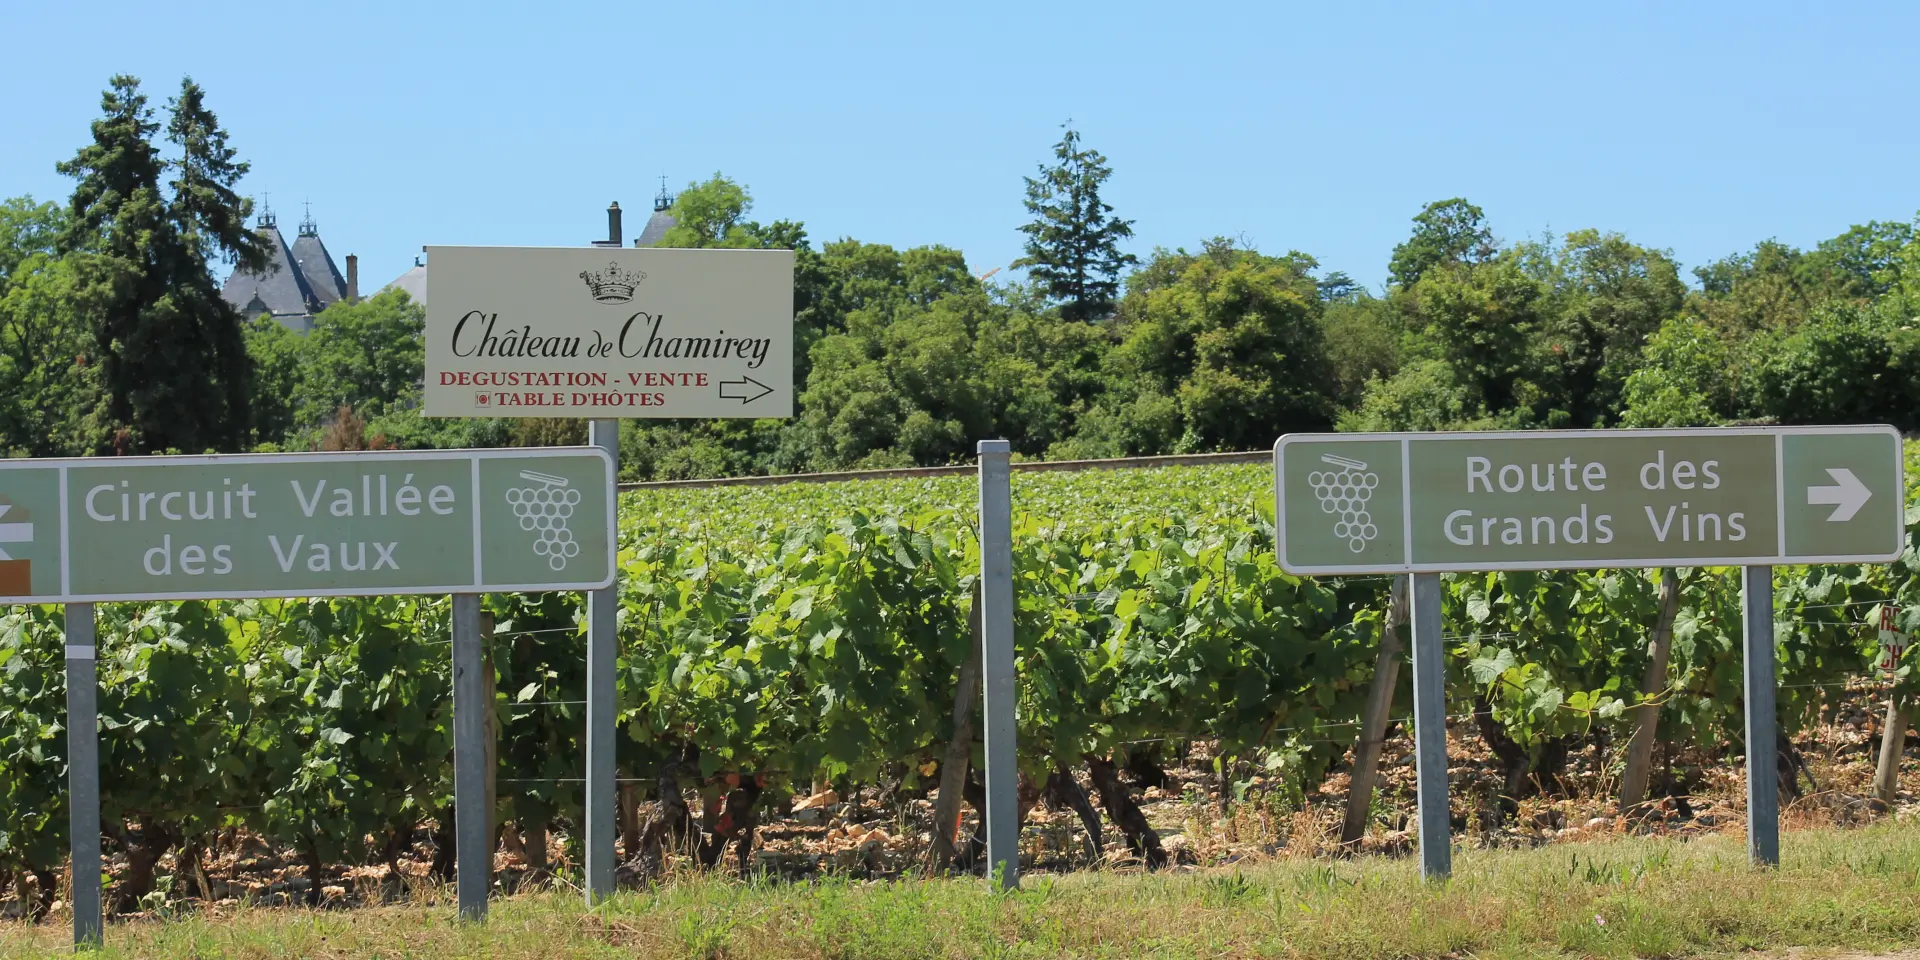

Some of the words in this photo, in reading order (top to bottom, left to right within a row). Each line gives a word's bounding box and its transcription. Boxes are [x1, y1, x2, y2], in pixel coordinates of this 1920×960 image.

[451, 310, 580, 358] Château
[587, 329, 613, 358] de
[618, 311, 771, 369] Chamirey
[439, 371, 607, 387] DEGUSTATION
[629, 371, 709, 387] VENTE
[494, 391, 566, 407] TABLE
[571, 389, 665, 407] D'HÔTES
[1466, 456, 1606, 493] Route
[1639, 449, 1720, 490] des
[85, 478, 257, 522] Circuit
[291, 473, 455, 517] Vallée
[1443, 503, 1614, 546] Grands
[1644, 501, 1746, 542] Vins
[143, 534, 233, 576] des
[268, 534, 400, 573] Vaux
